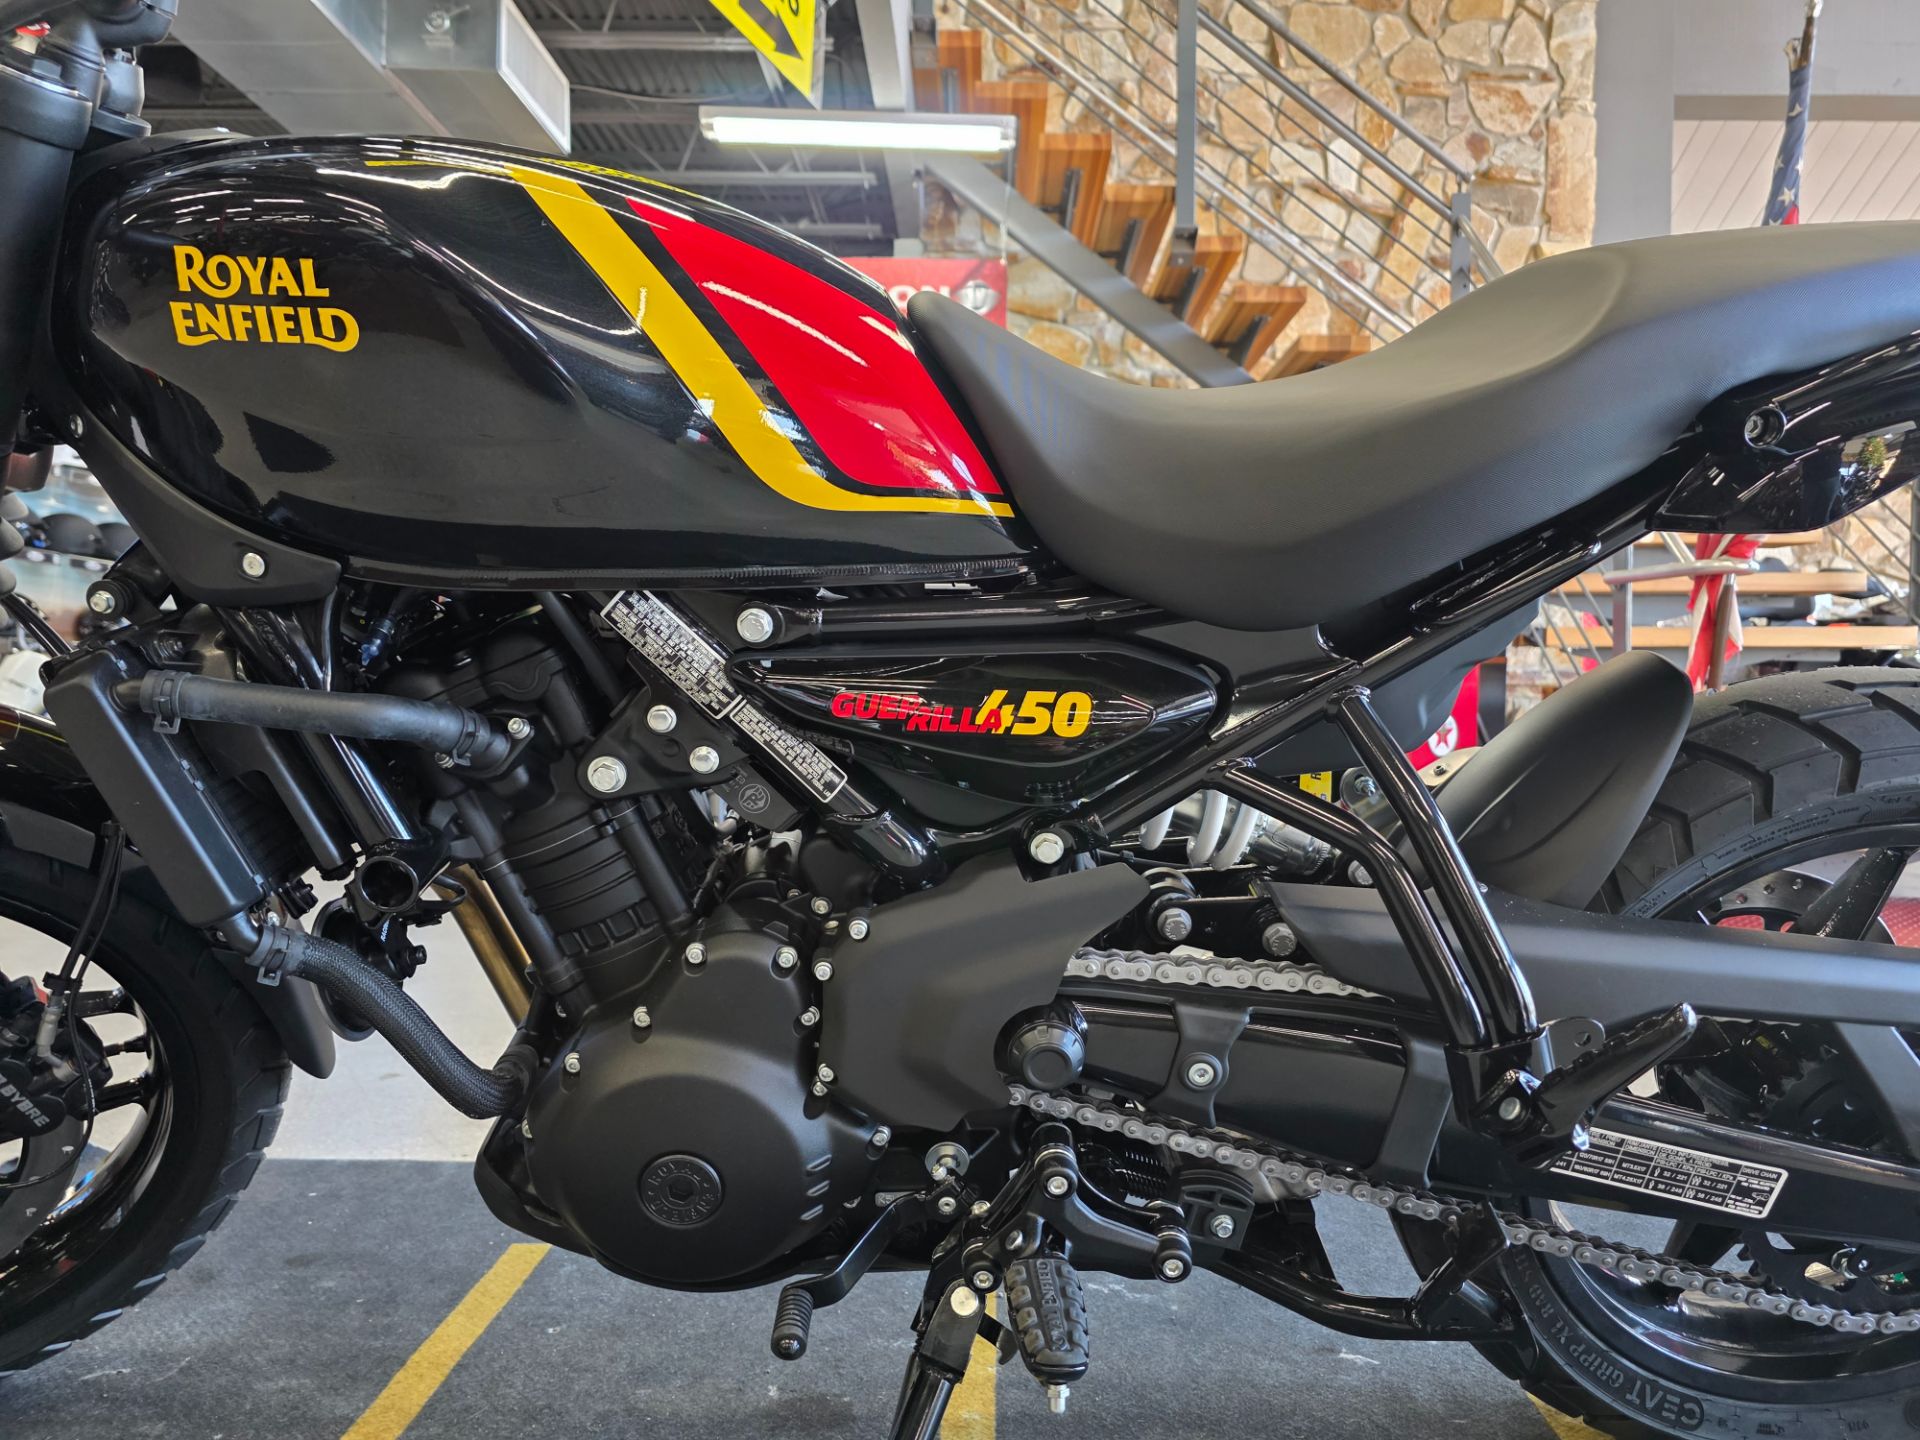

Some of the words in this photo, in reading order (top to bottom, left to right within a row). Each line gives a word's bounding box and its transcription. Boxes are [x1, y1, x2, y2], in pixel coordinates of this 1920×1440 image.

[173, 245, 329, 298] ROYAL
[169, 301, 360, 352] ENFIELD
[831, 692, 1002, 734] GUERRILLA
[975, 689, 1093, 737] 450
[0, 1084, 50, 1127] BYBRE
[1741, 1166, 1760, 1175] DRIVE
[1759, 1170, 1778, 1179] CHAIN
[1569, 1343, 1625, 1387] GRIPP
[1625, 1378, 1701, 1426] CEAT
